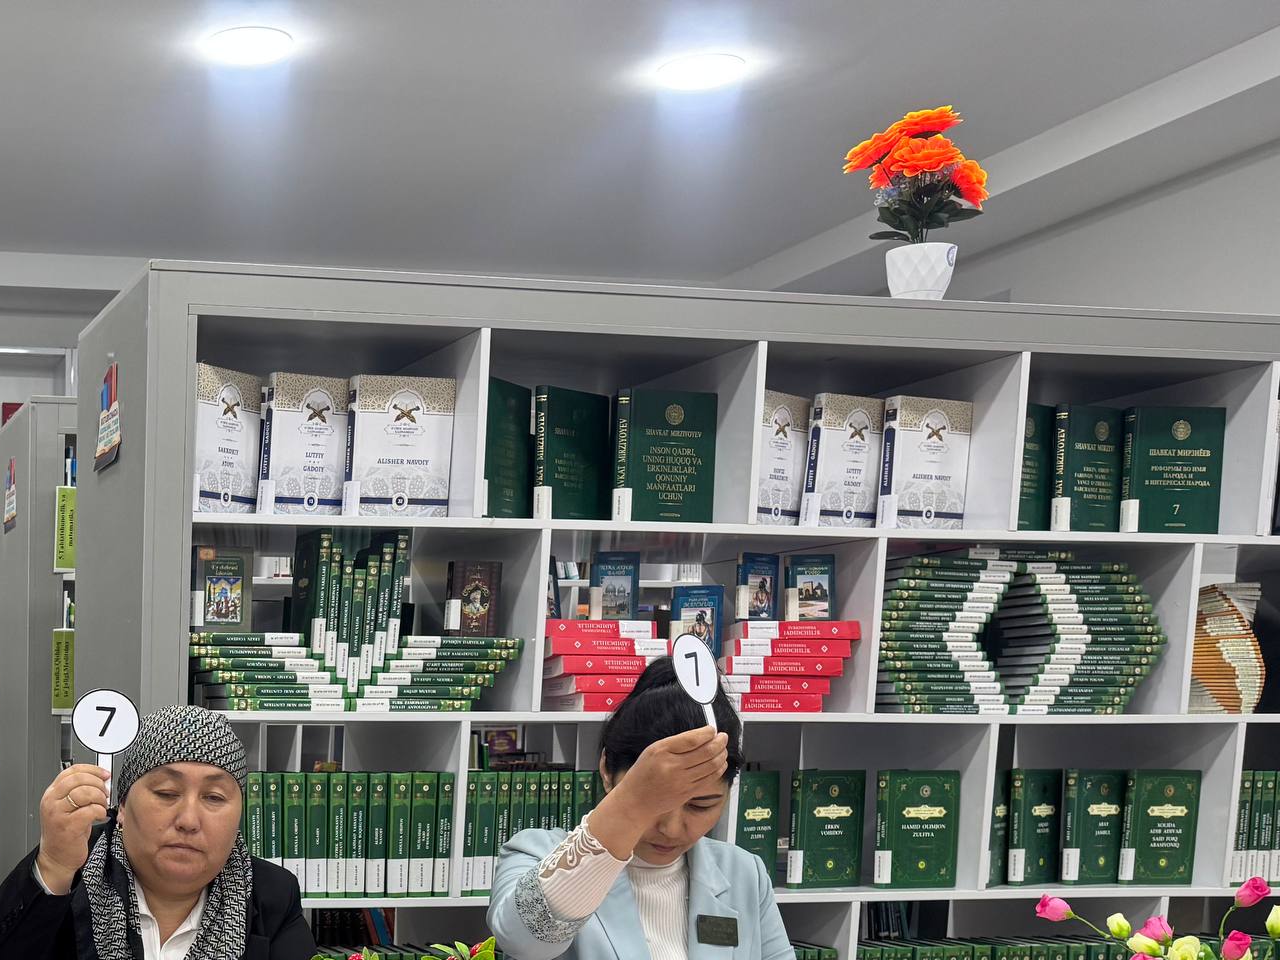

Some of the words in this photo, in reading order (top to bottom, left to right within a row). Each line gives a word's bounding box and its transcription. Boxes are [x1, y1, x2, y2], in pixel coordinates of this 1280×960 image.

[650, 446, 671, 455] INSON
[376, 458, 404, 466] ALISHER
[406, 458, 429, 466] NAVOIY
[642, 455, 667, 464] UNING
[667, 456, 691, 466] HUQUQ
[692, 457, 703, 465] VA
[303, 465, 325, 473] GADOIY
[655, 474, 688, 483] QONUNIY
[646, 482, 696, 492] MANFAATLARI
[658, 492, 683, 500] UCHUN
[1172, 504, 1180, 515] 7
[685, 651, 700, 687] 7
[95, 705, 117, 738] 7
